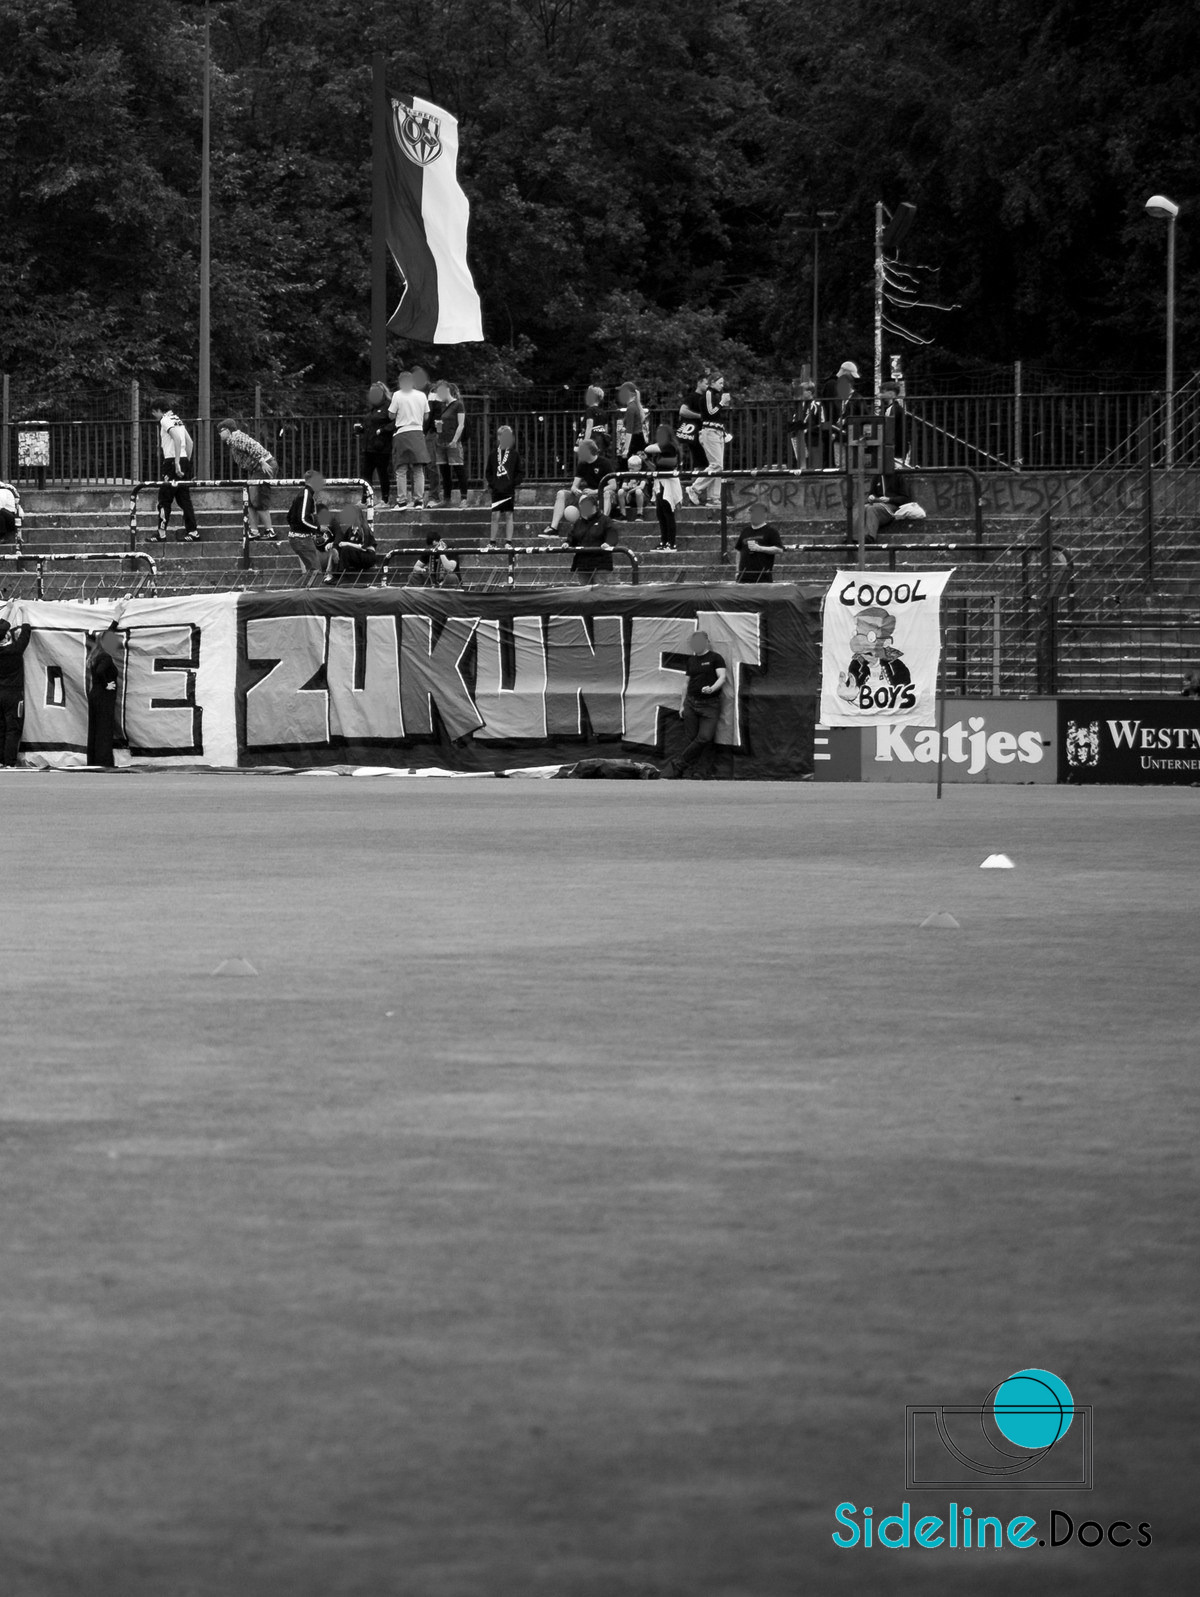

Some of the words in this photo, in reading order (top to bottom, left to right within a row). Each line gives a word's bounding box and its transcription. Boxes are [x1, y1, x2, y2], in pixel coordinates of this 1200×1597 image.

[840, 580, 927, 607] COOOL
[236, 609, 762, 753] ZUKUNFT
[858, 683, 916, 709] BOYS
[875, 717, 1044, 774] Katjes
[1140, 756, 1200, 770] UNTERNE
